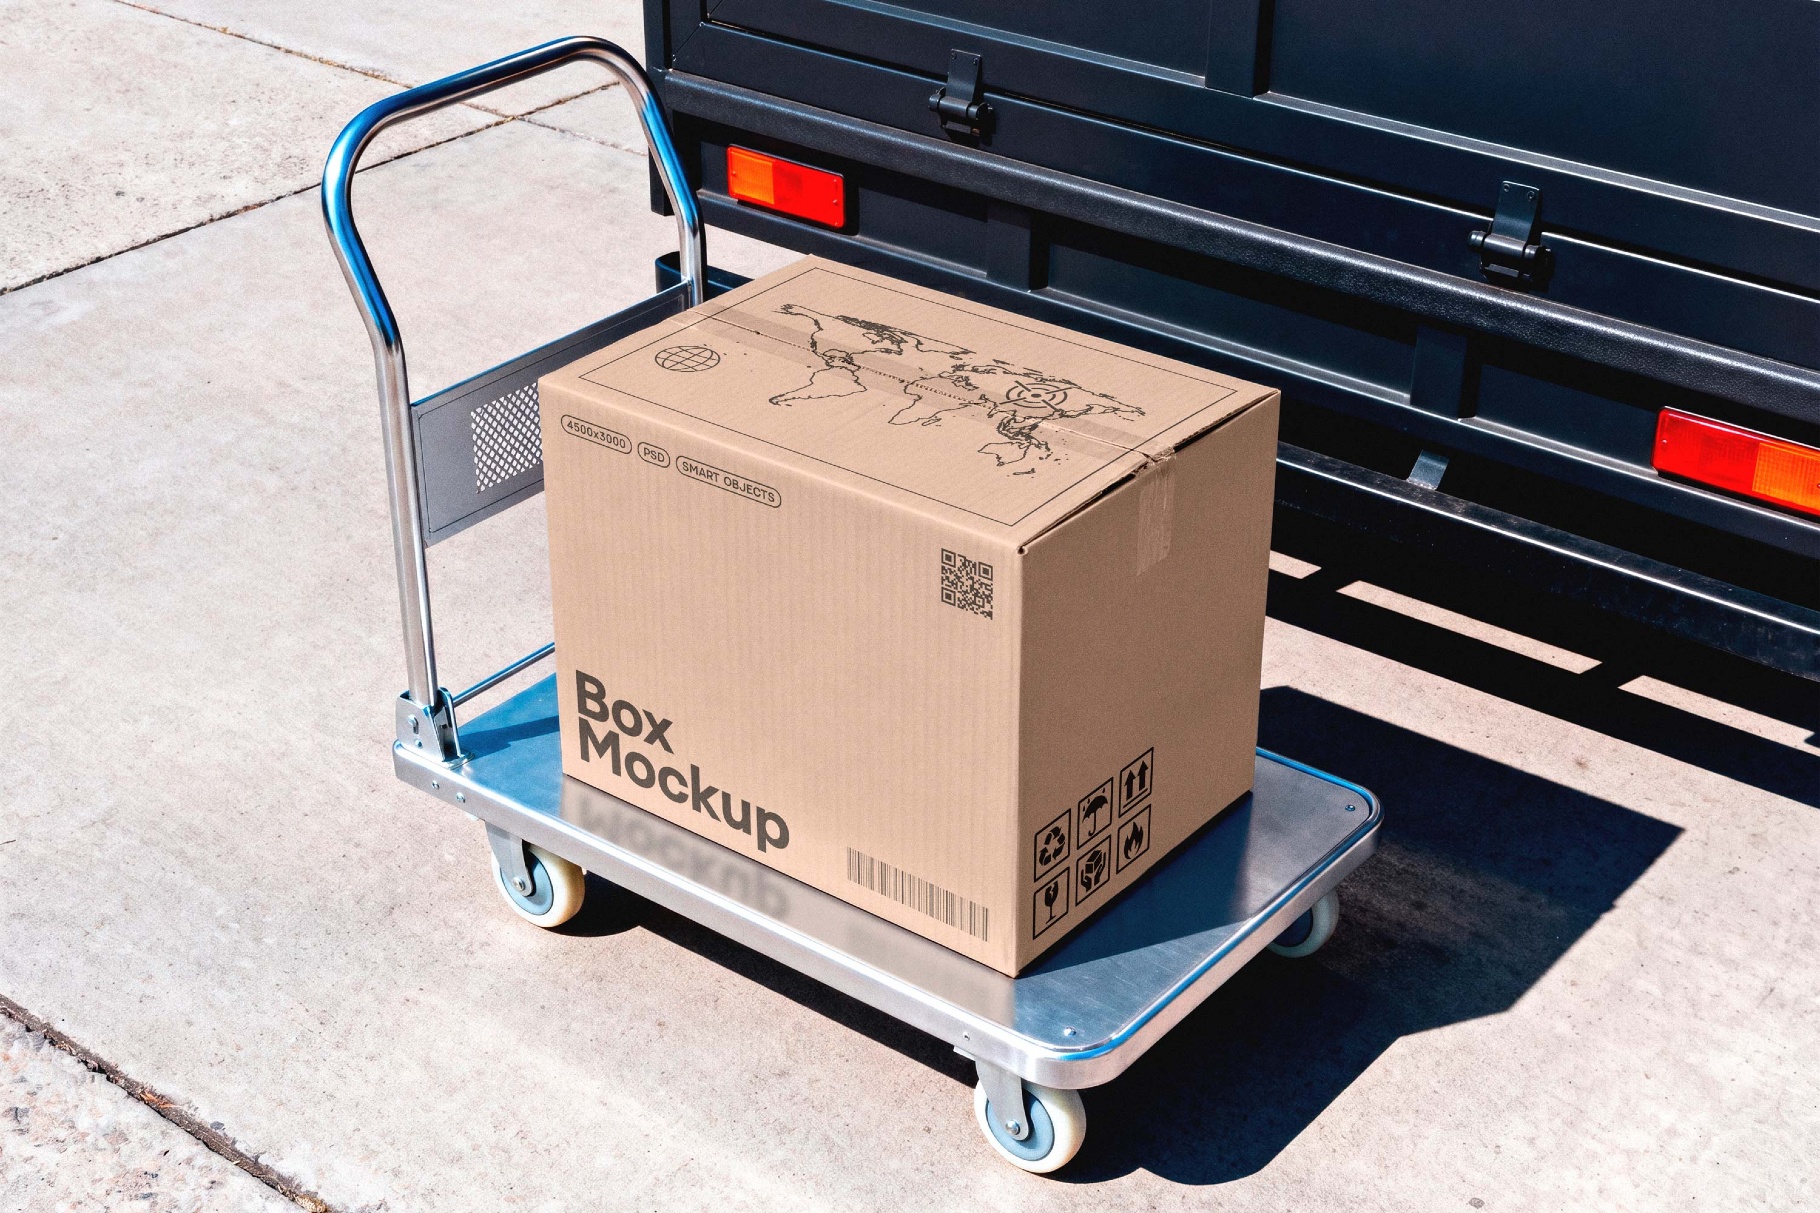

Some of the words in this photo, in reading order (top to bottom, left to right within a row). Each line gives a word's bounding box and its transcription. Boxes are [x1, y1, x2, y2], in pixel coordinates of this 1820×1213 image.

[566, 420, 626, 449] 4500x3000
[643, 447, 665, 463] PSD
[682, 461, 720, 483] SMART
[723, 476, 775, 503] OBJECTS
[575, 669, 674, 755] Box
[578, 716, 790, 853] Mockup
